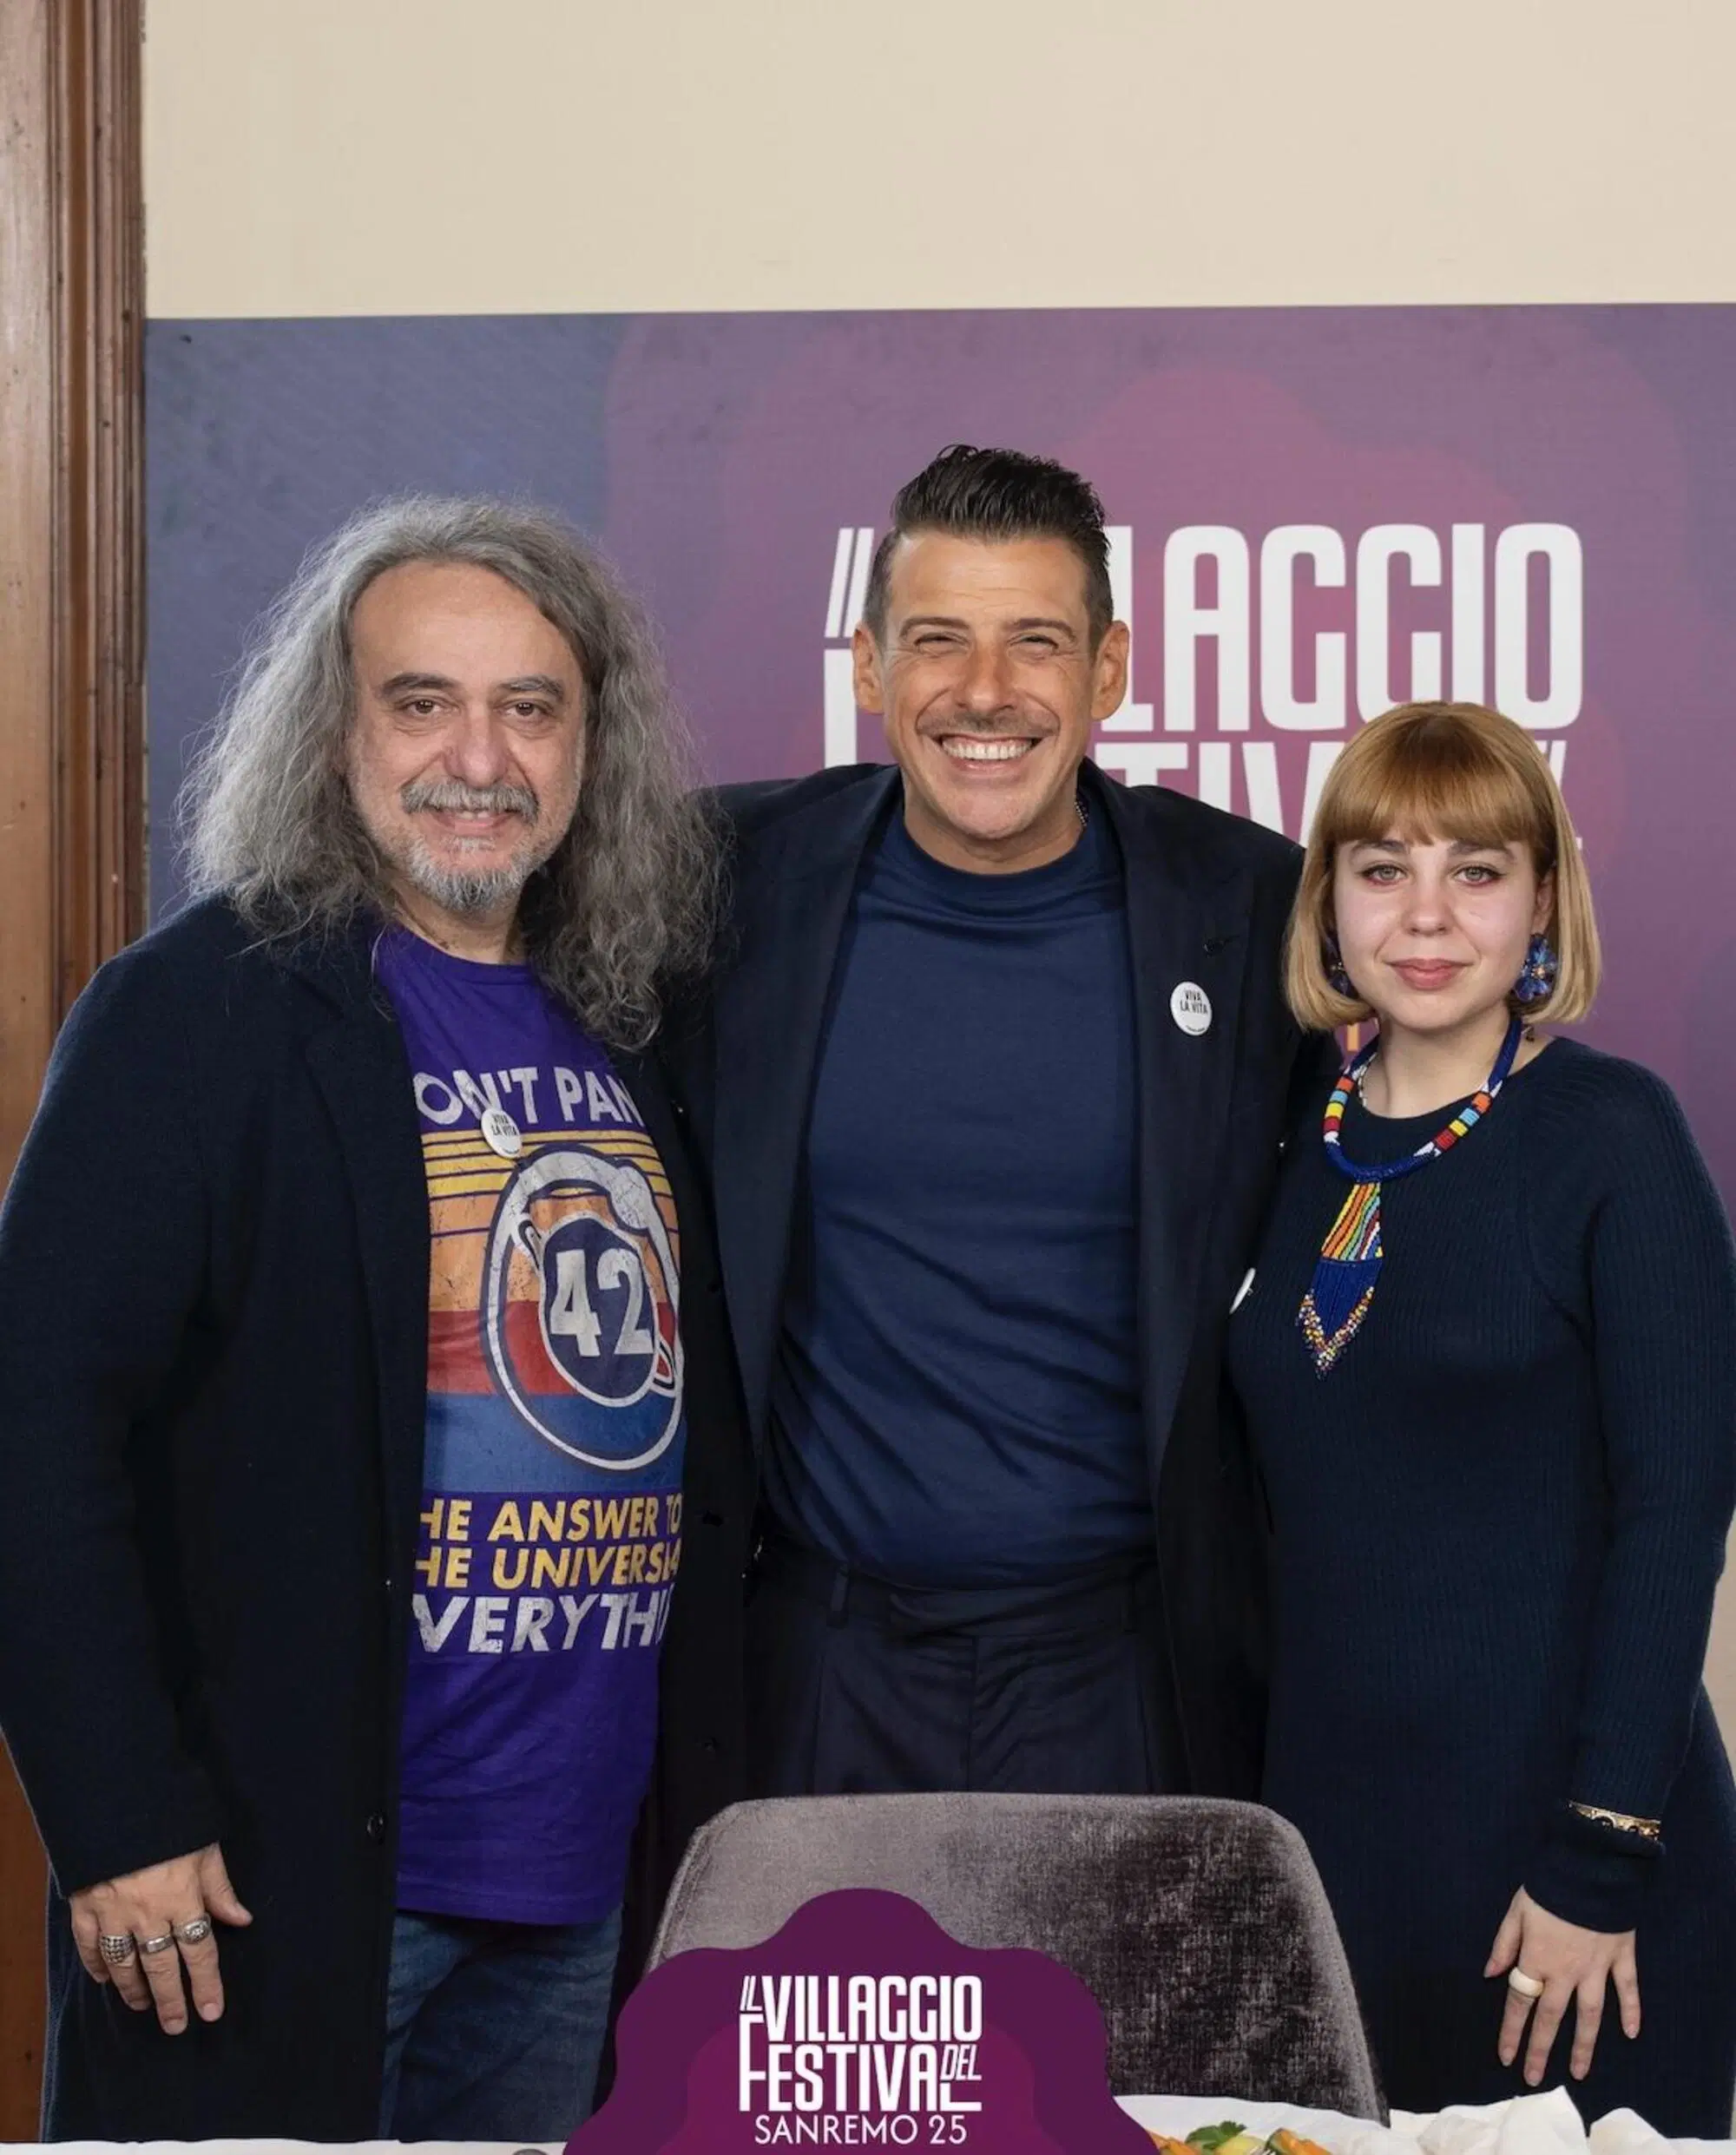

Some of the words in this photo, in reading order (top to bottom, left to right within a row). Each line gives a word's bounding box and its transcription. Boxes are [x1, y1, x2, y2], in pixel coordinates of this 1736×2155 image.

[1180, 1000, 1190, 1013] LA
[1192, 1002, 1208, 1015] VITA
[1184, 989, 1201, 1001] VIVA
[412, 1066, 539, 1126] ON'T
[554, 1066, 645, 1127] PAN
[491, 1114, 510, 1124] VIVA
[491, 1125, 503, 1136] LA
[503, 1125, 518, 1136] VITA
[549, 1248, 654, 1357] 42
[420, 1498, 473, 1541] HE
[487, 1497, 659, 1542] ANSWER
[667, 1493, 683, 1535] TO
[415, 1546, 473, 1589] HE
